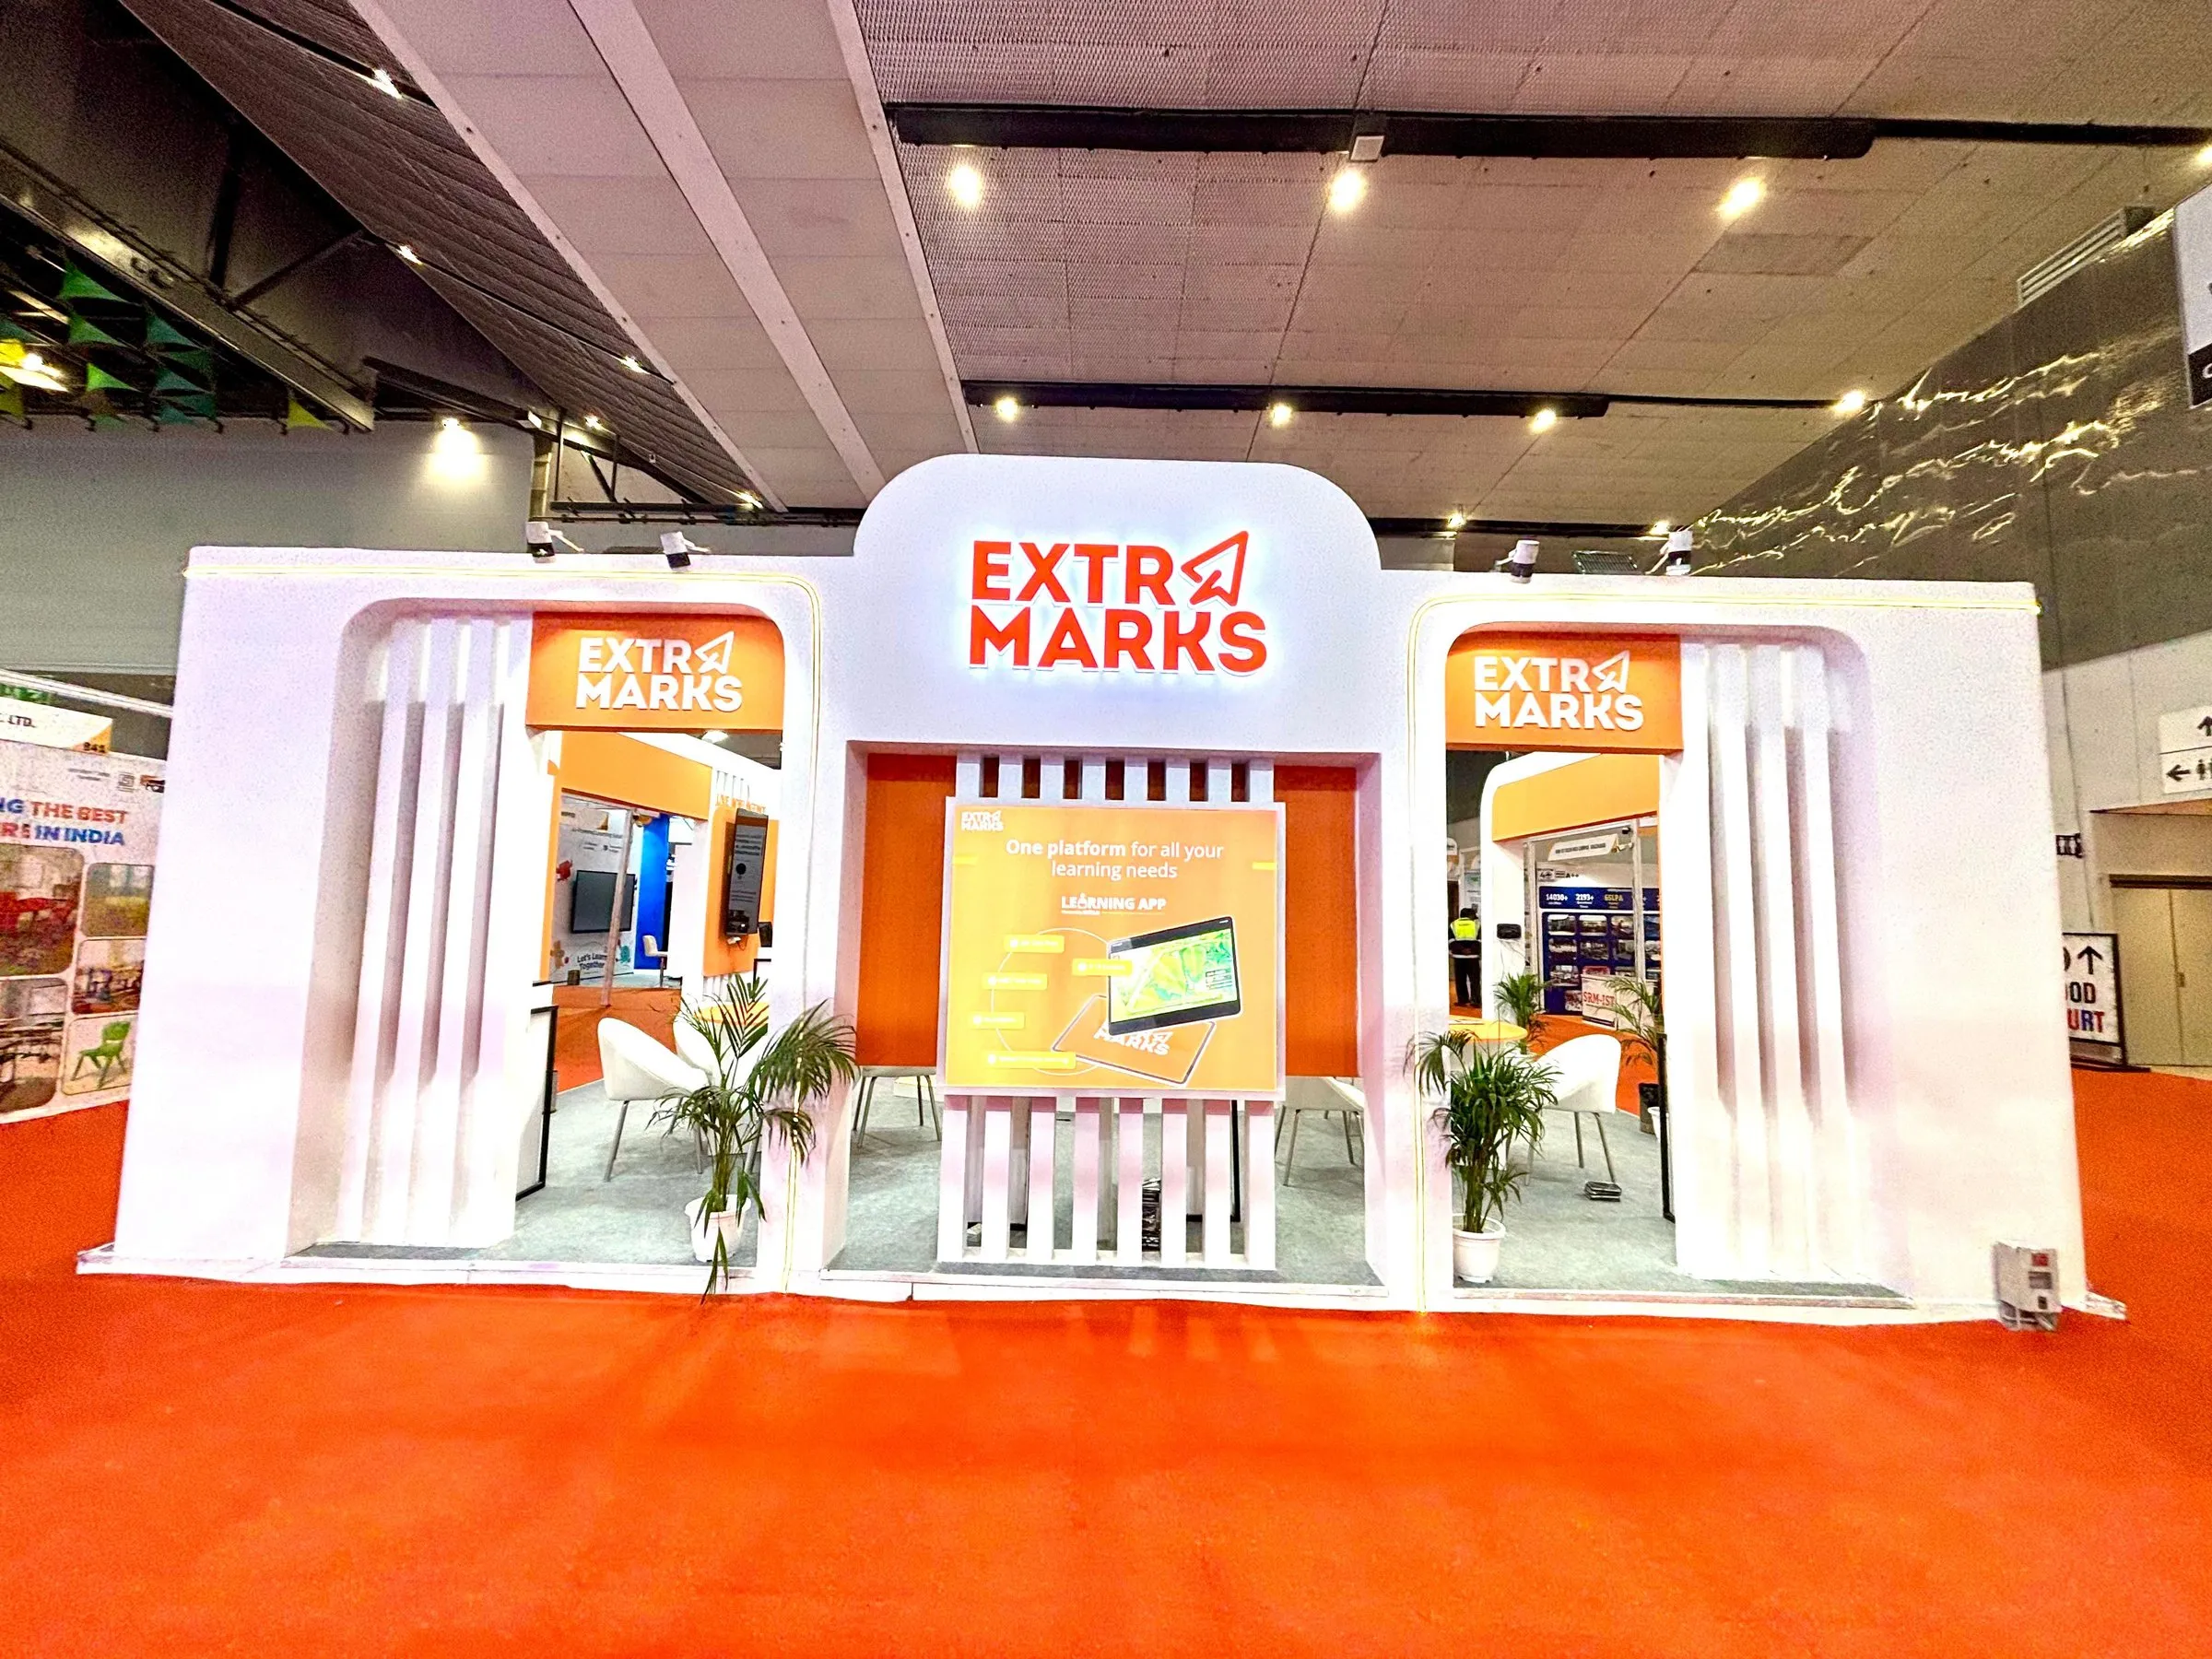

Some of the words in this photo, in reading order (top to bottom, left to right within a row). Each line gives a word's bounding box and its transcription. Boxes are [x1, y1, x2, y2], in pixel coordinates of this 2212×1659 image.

[970, 606, 1267, 674] MARKS
[576, 674, 743, 712] MARKS
[1475, 692, 1644, 731] MARKS
[30, 801, 73, 818] THE
[76, 806, 128, 824] BEST
[34, 825, 60, 841] IN
[64, 828, 124, 845] INDIA
[1006, 840, 1042, 855] One
[1047, 840, 1125, 859] platform
[1131, 841, 1157, 856] for
[1160, 841, 1180, 857] all
[1183, 845, 1224, 862] your
[1052, 860, 1122, 881] learning
[1126, 863, 1178, 877] needs
[1061, 893, 1135, 911] LEARNING
[1137, 898, 1167, 911] APP
[1583, 991, 1615, 1006] SRM-IST
[2065, 982, 2096, 1004] OD
